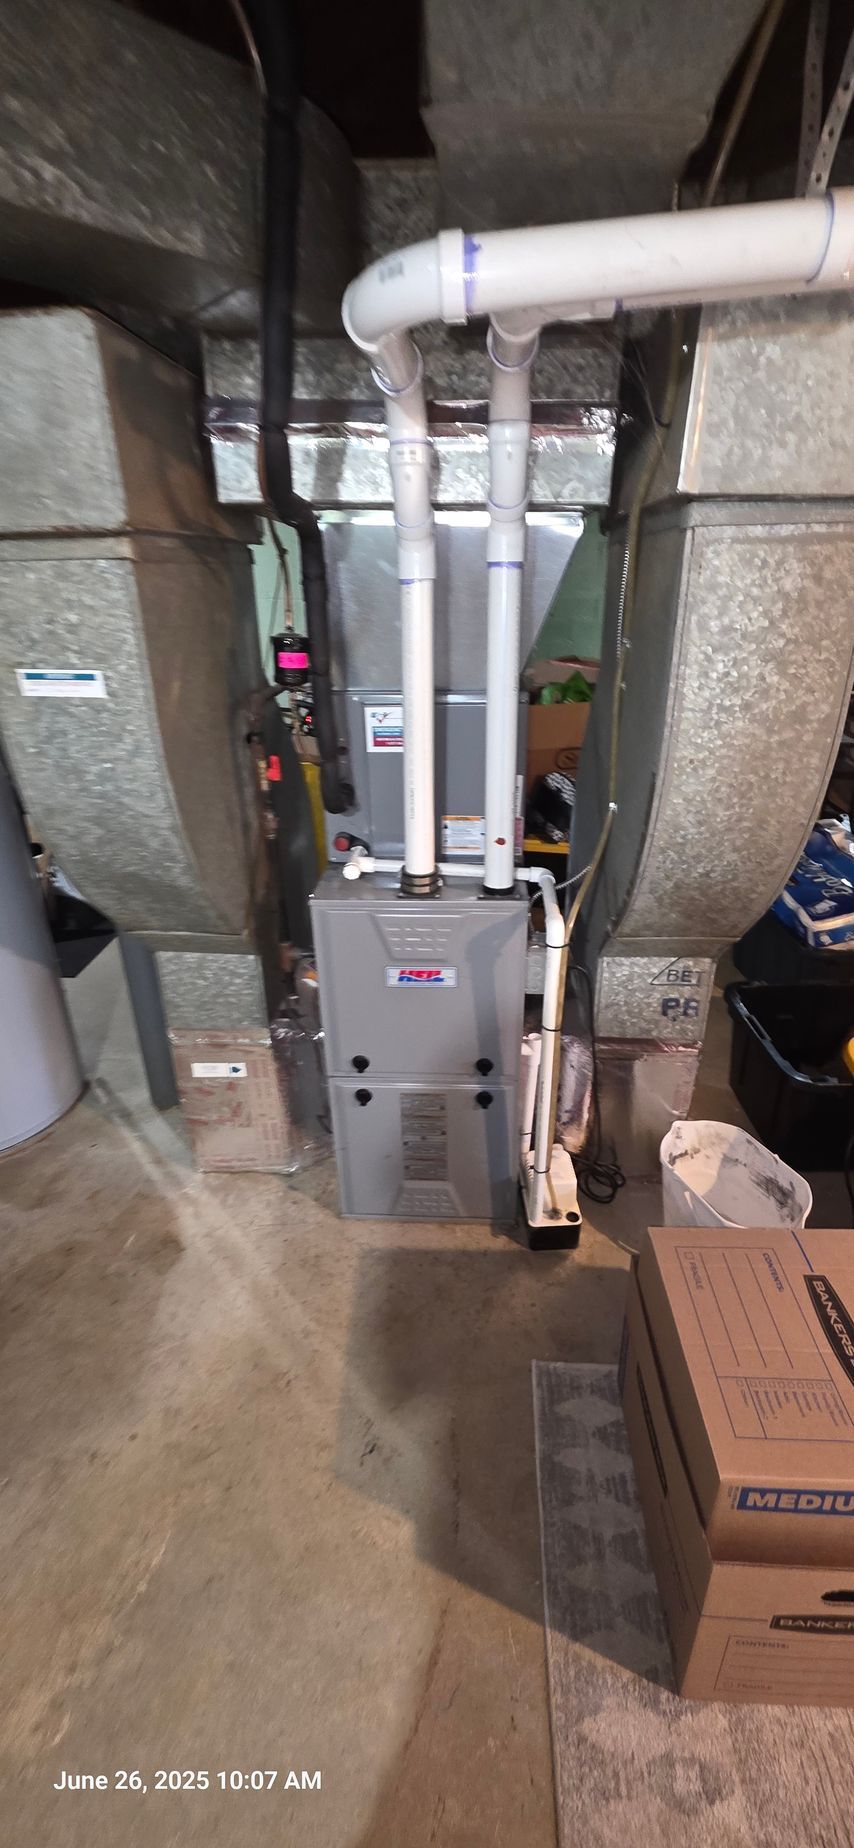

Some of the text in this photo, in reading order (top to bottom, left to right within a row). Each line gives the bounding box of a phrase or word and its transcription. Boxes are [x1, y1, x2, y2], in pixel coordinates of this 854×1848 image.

[666, 969, 706, 983] BET
[812, 1280, 854, 1357] BANKERS
[745, 1492, 854, 1513] MEDIU
